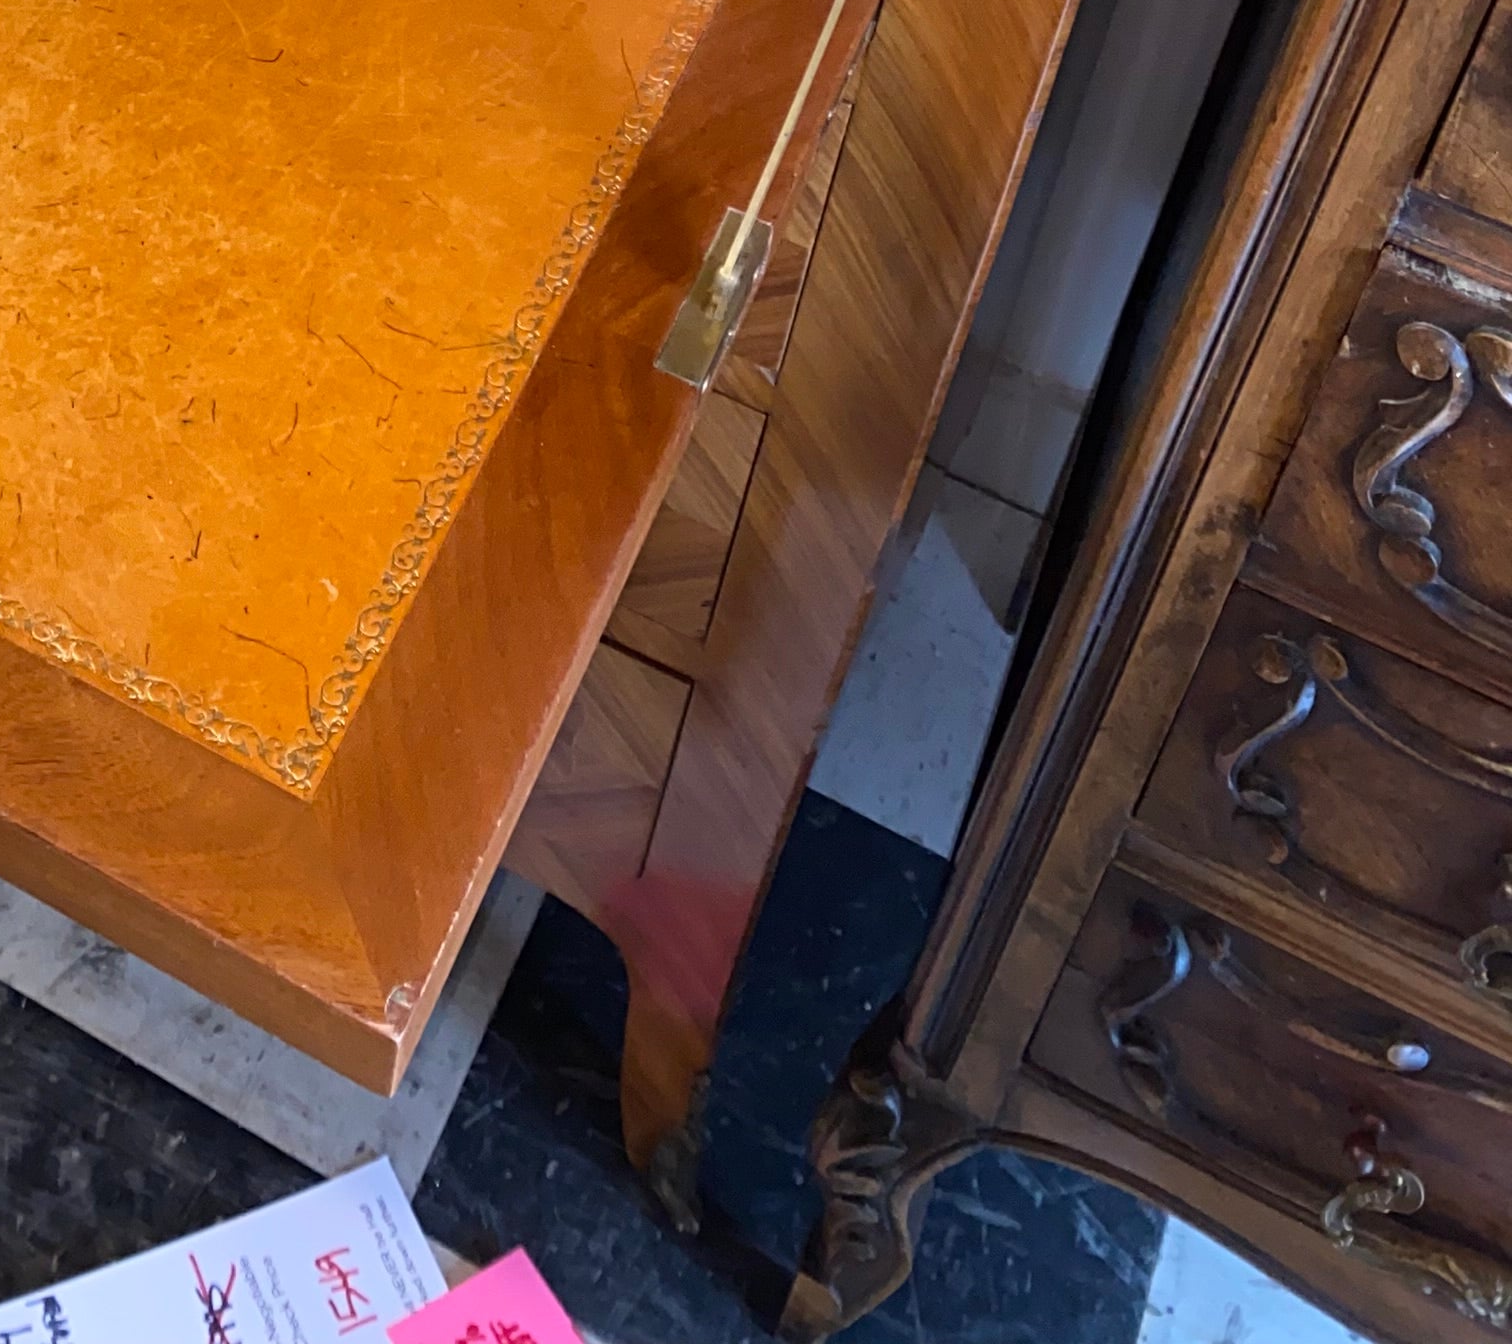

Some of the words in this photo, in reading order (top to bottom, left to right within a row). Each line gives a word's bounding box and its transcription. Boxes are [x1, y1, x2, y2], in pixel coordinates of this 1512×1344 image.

[263, 1255, 285, 1299] Price
[315, 1246, 377, 1336] 1549
[381, 1250, 407, 1299] NEVER
